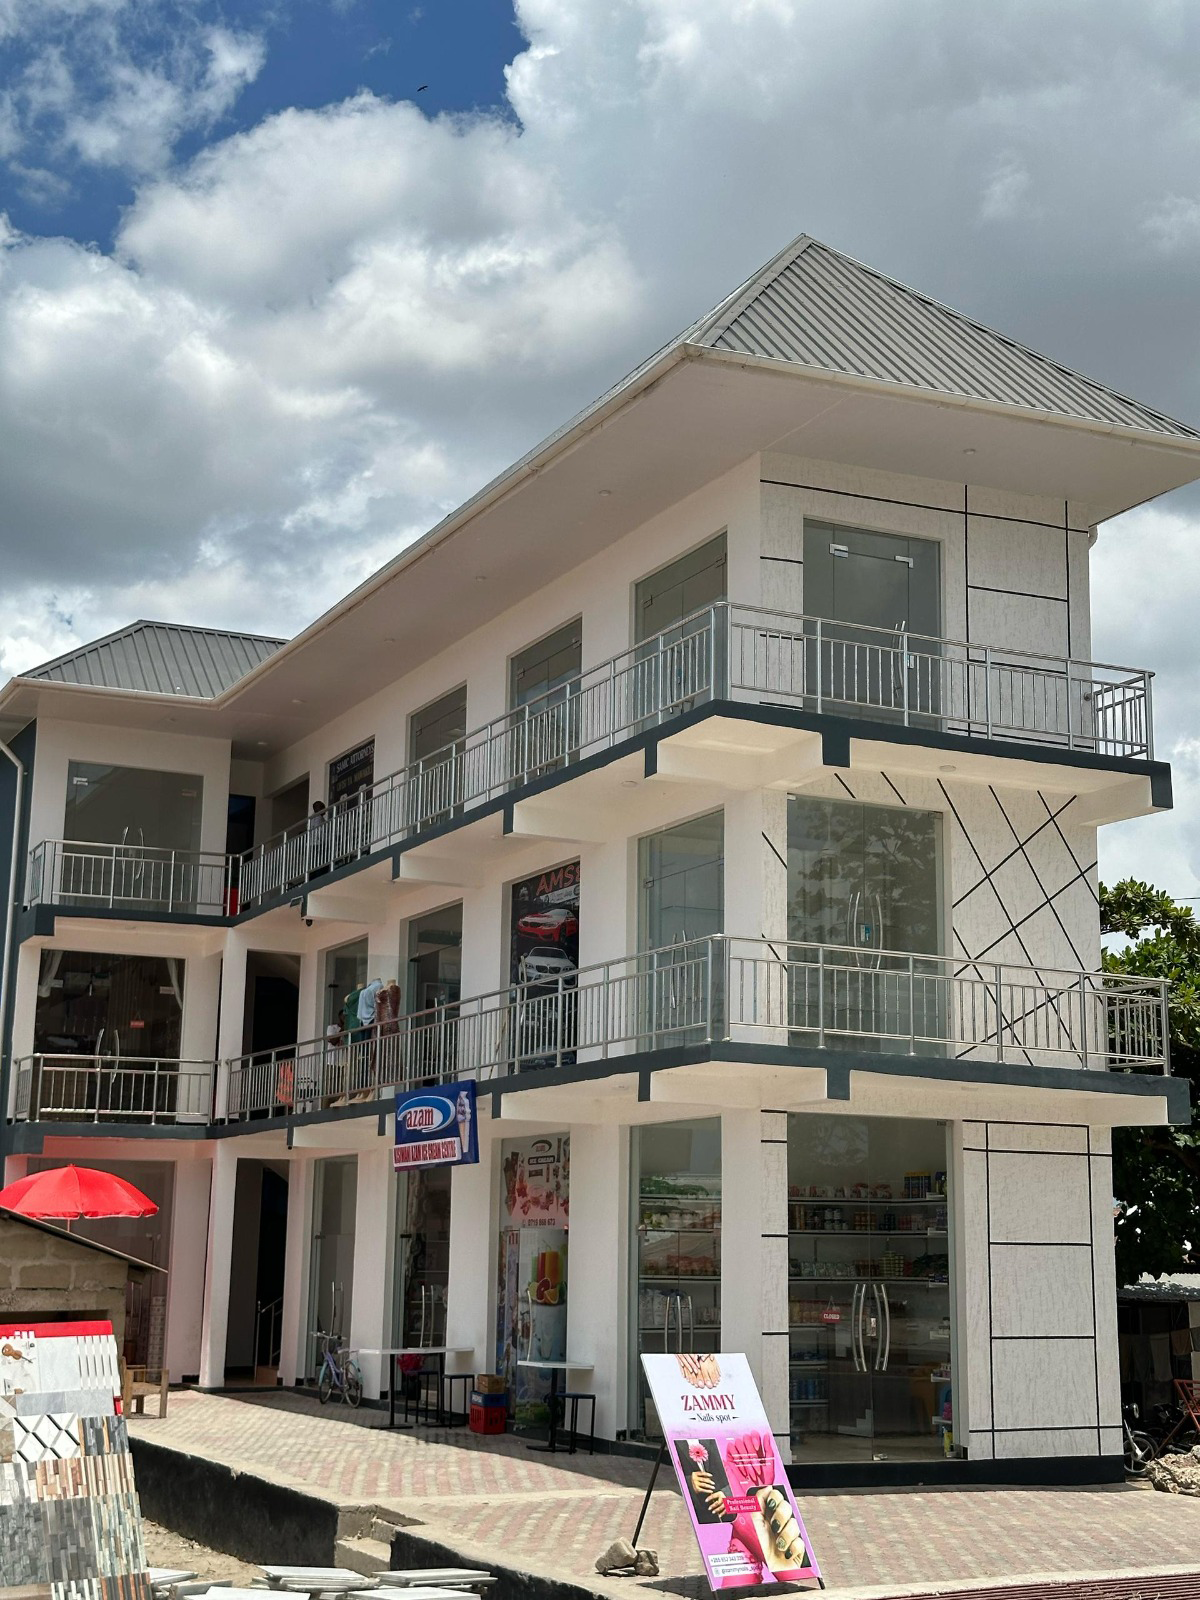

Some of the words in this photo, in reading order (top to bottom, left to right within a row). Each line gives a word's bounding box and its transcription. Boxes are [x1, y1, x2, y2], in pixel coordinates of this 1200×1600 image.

[406, 1108, 434, 1128] azam
[680, 1394, 735, 1411] ZAMMY
[696, 1413, 715, 1422] Nails
[715, 1413, 732, 1424] spot
[726, 1497, 756, 1505] Professional
